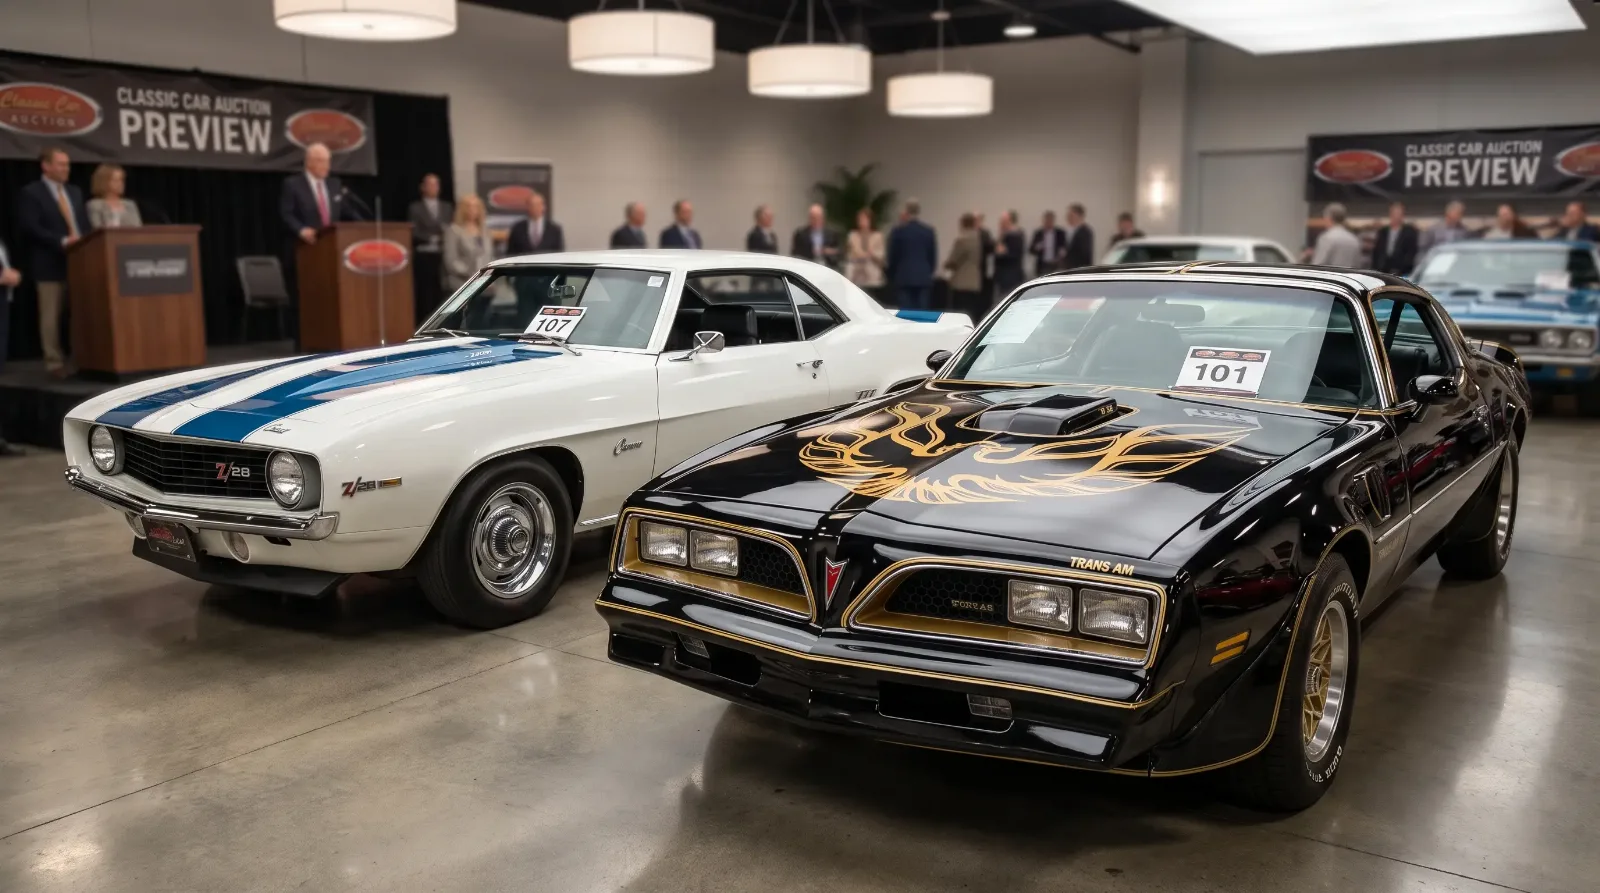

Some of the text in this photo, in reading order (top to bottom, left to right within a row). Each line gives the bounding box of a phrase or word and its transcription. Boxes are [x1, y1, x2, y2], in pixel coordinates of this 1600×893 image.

[116, 87, 272, 116] CLASSIC CAR AUCTION
[11, 114, 76, 127] AUCTION
[119, 108, 272, 155] PREVIEW
[1405, 140, 1543, 158] CLASSIC CAR AUCTION
[1404, 156, 1541, 187] PREVIEW
[535, 318, 572, 333] 107
[1195, 363, 1248, 384] 101
[215, 462, 250, 483] Z/28
[1070, 556, 1135, 576] TRANS AM
